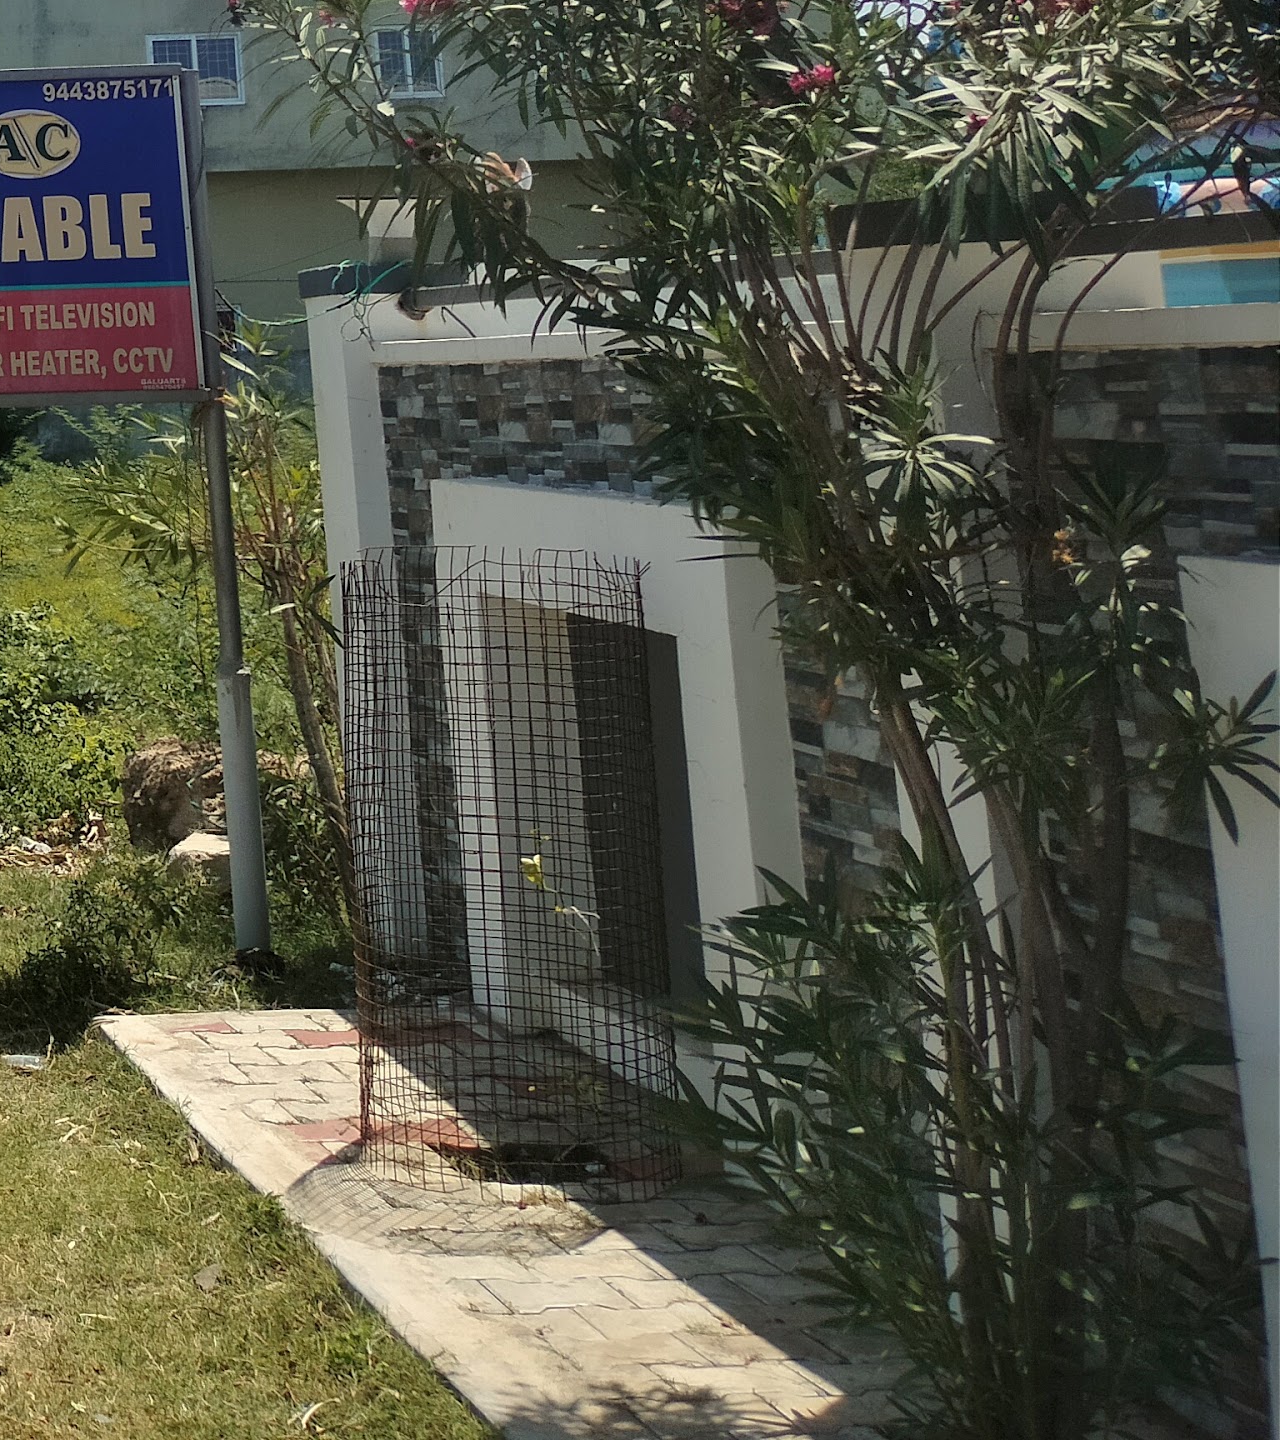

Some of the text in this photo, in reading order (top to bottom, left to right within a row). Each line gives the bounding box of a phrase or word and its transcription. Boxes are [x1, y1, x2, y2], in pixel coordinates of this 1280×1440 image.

[43, 78, 174, 103] 9443875171
[20, 301, 156, 331] TELEVISION
[10, 348, 108, 380] HEATER,
[112, 346, 174, 375] CCTV
